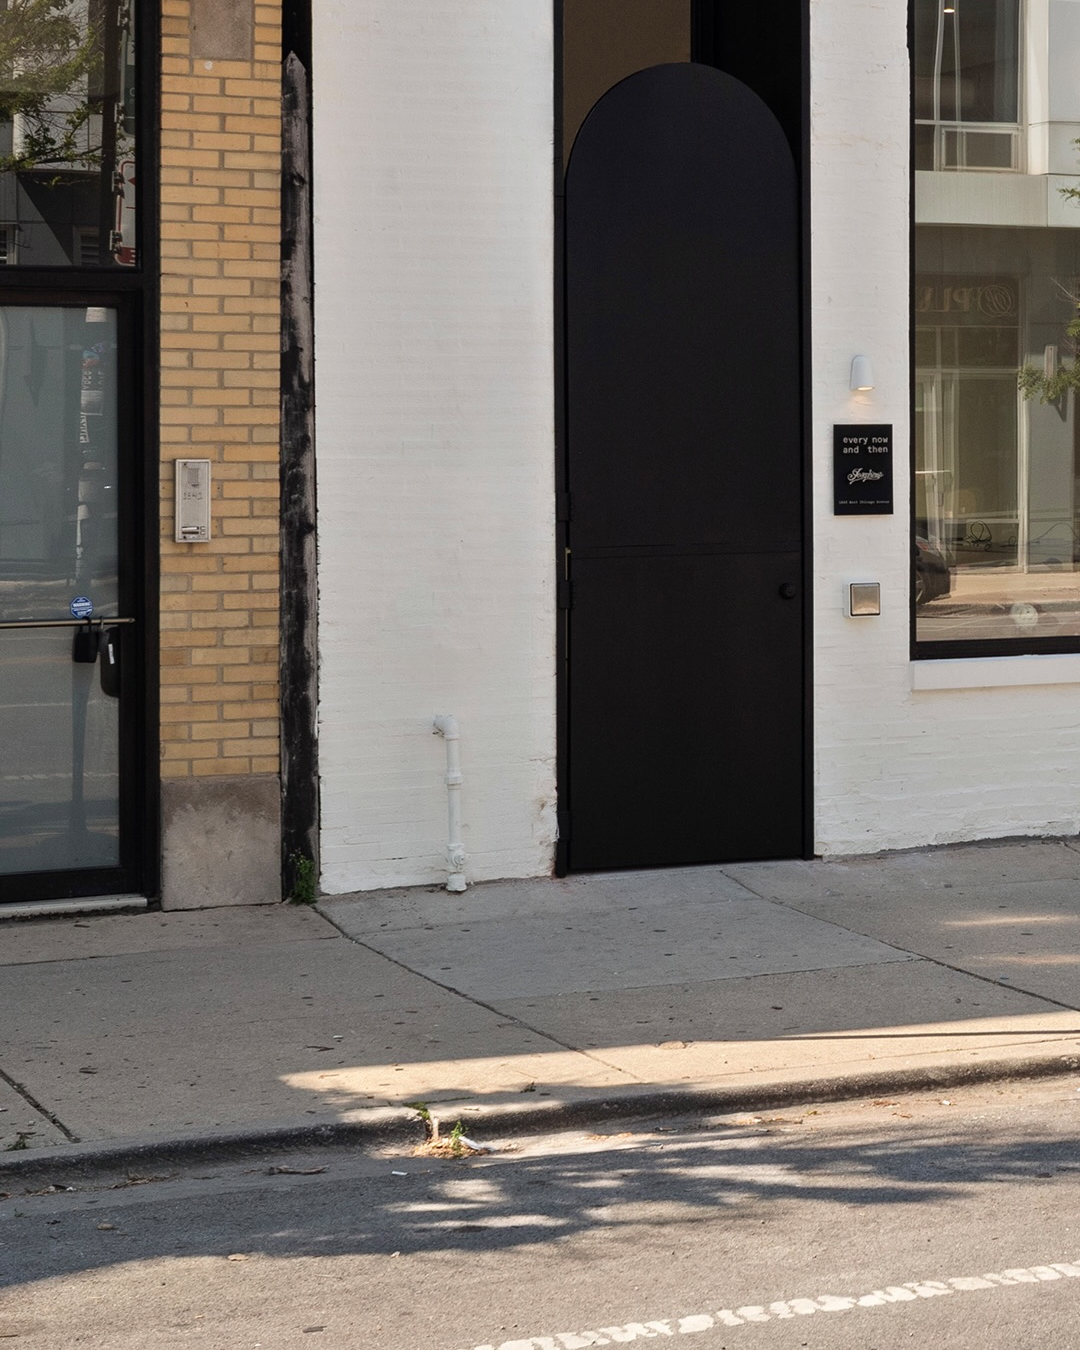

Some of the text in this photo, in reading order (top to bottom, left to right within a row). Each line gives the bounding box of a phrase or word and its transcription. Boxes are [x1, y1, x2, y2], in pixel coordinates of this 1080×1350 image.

[843, 437, 868, 446] every
[843, 446, 889, 454] and then
